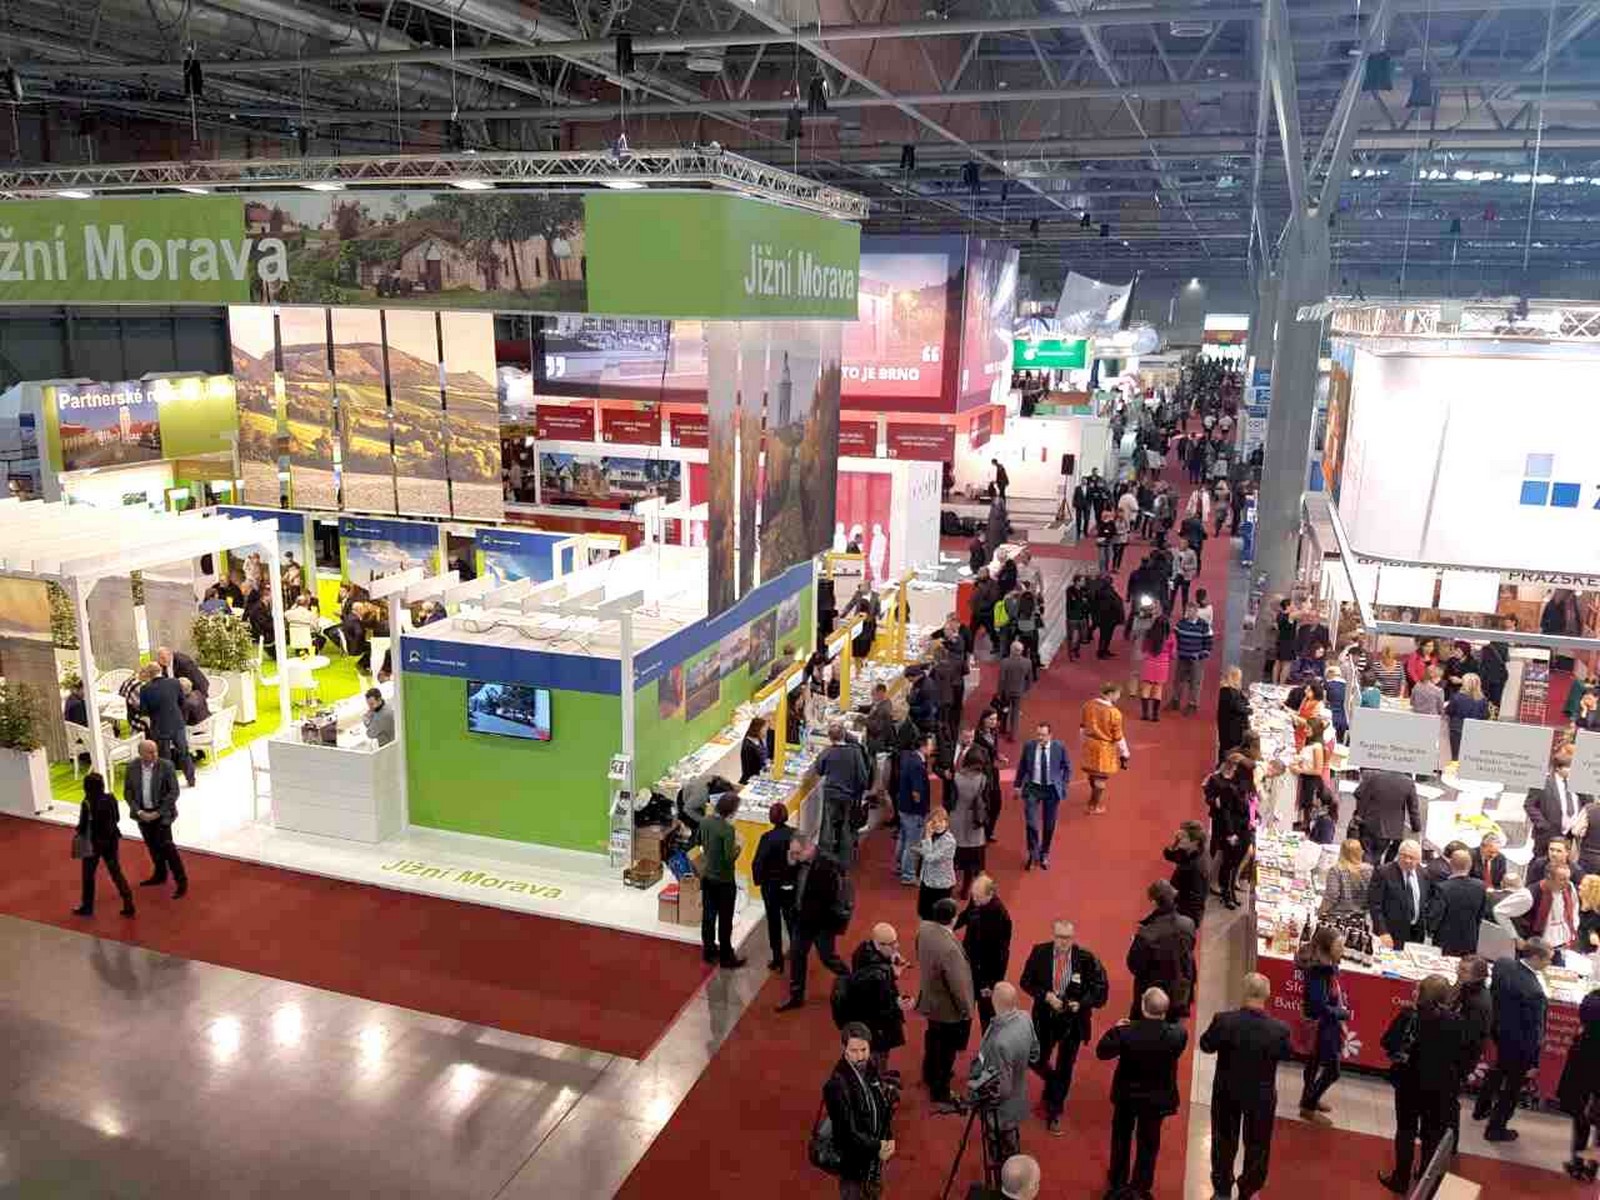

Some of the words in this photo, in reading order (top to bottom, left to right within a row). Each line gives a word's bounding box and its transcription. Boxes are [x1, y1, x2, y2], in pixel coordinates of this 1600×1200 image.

[84, 224, 290, 282] Morava
[744, 242, 792, 296] Jižní
[797, 250, 855, 300] Morava
[861, 366, 877, 383] JE
[879, 367, 920, 381] BRNO
[59, 387, 143, 410] Partnerské
[381, 858, 452, 879] Jižní
[453, 869, 563, 900] Morava
